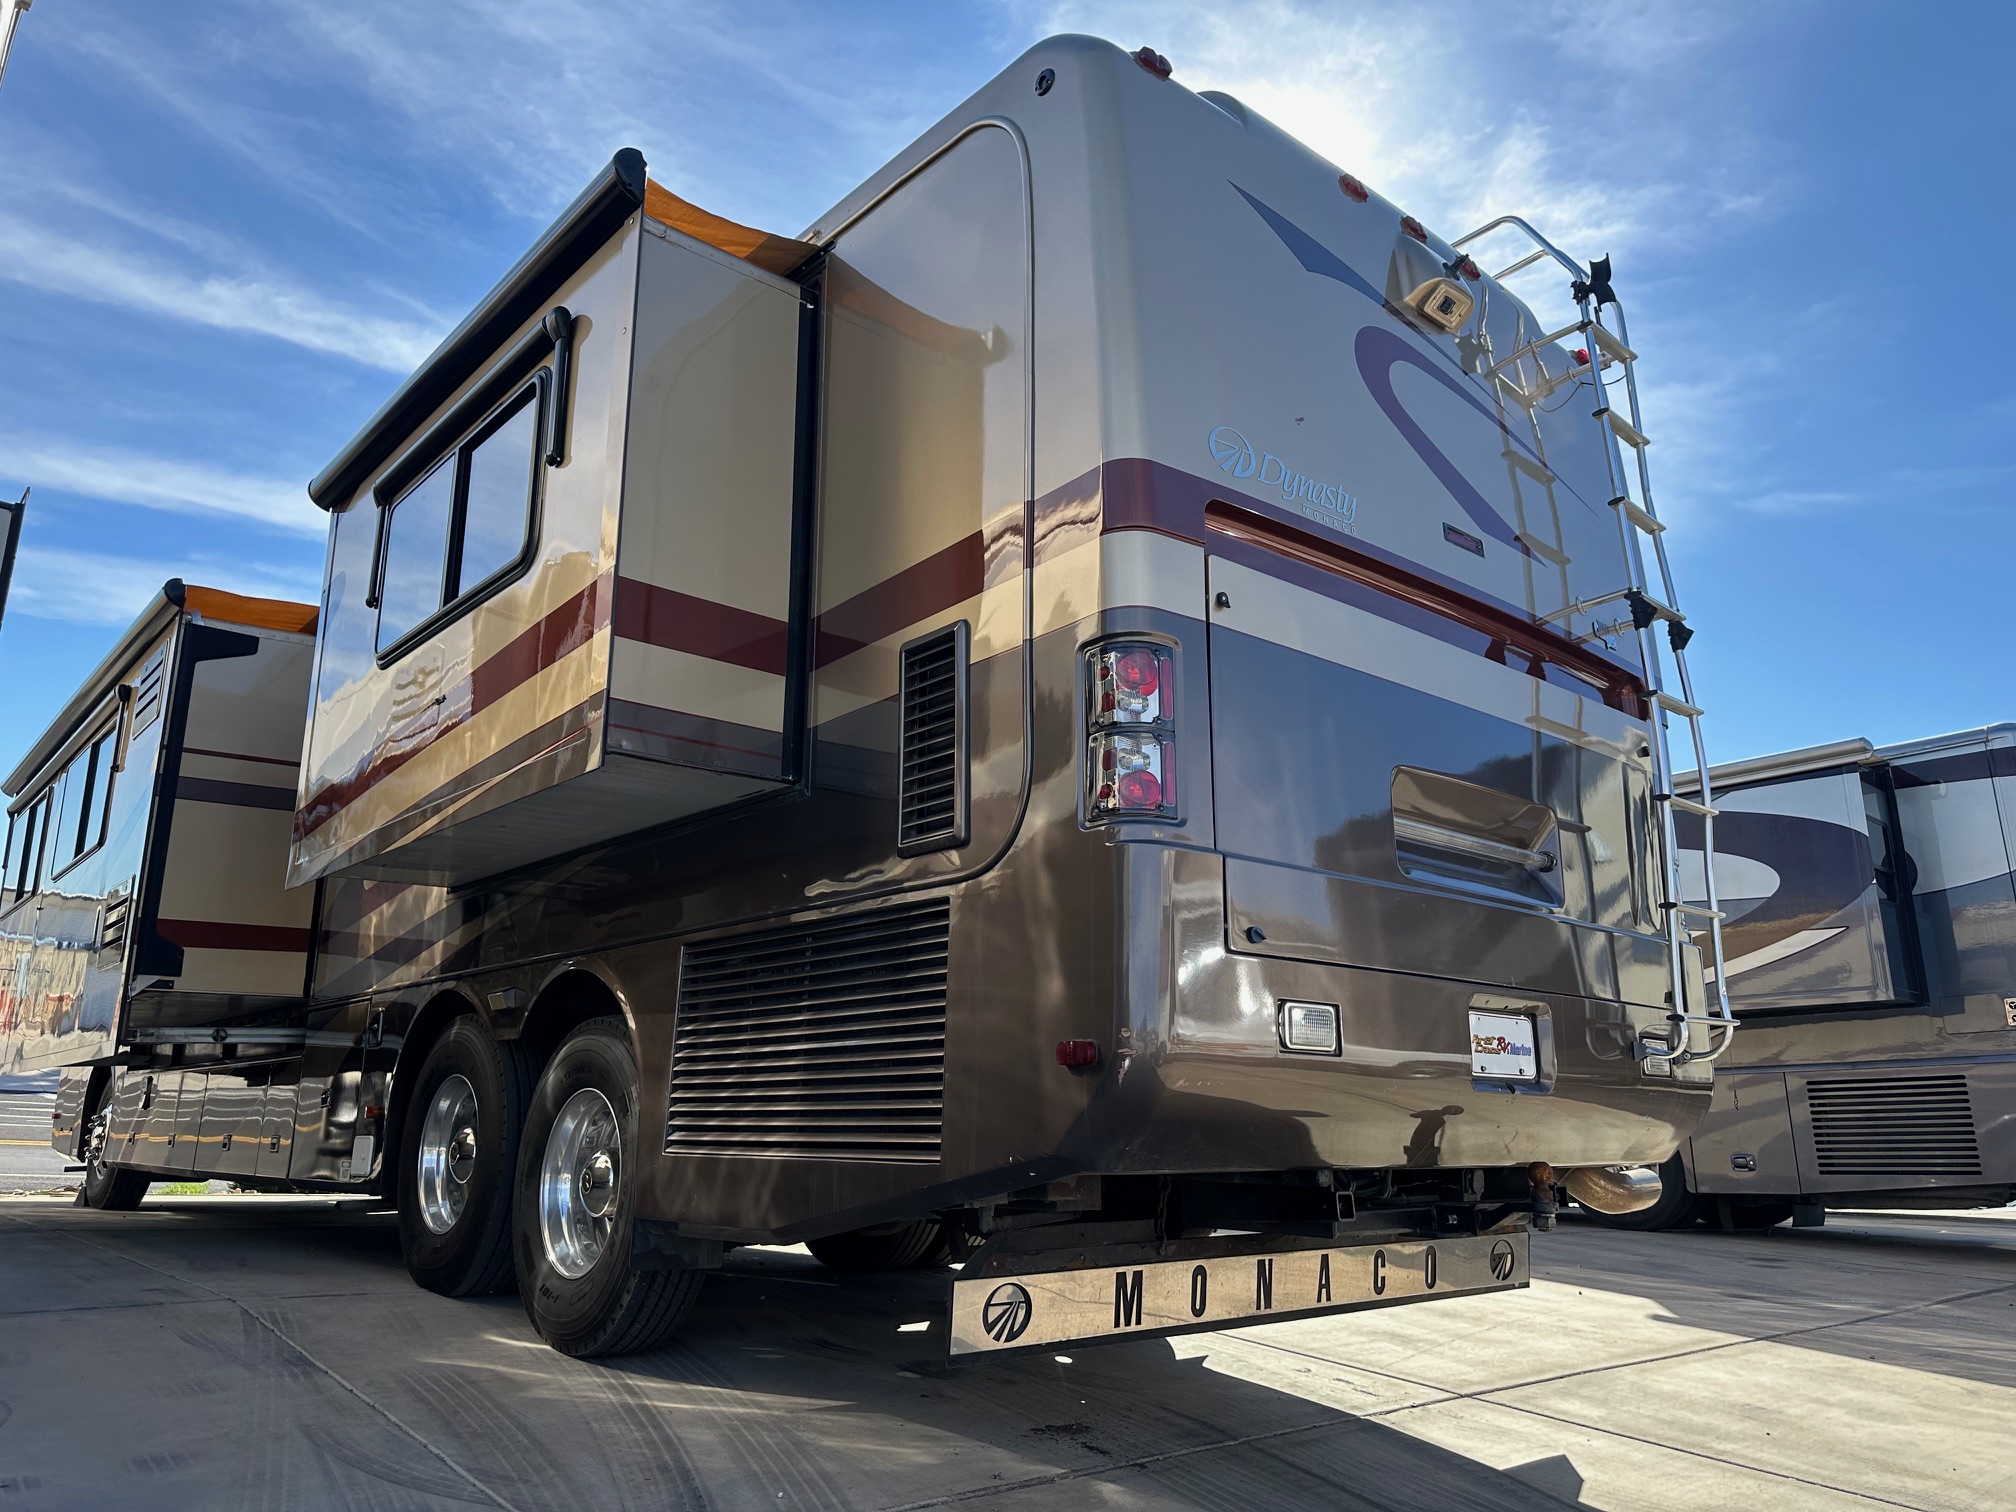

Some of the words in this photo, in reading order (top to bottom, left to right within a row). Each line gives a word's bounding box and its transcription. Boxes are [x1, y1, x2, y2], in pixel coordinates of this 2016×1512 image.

[1257, 451, 1358, 524] Dynasty
[1302, 506, 1357, 535] MONACO
[1497, 1036, 1510, 1053] RV
[1509, 1043, 1531, 1056] Marine
[1113, 1244, 1437, 1328] MONACO
